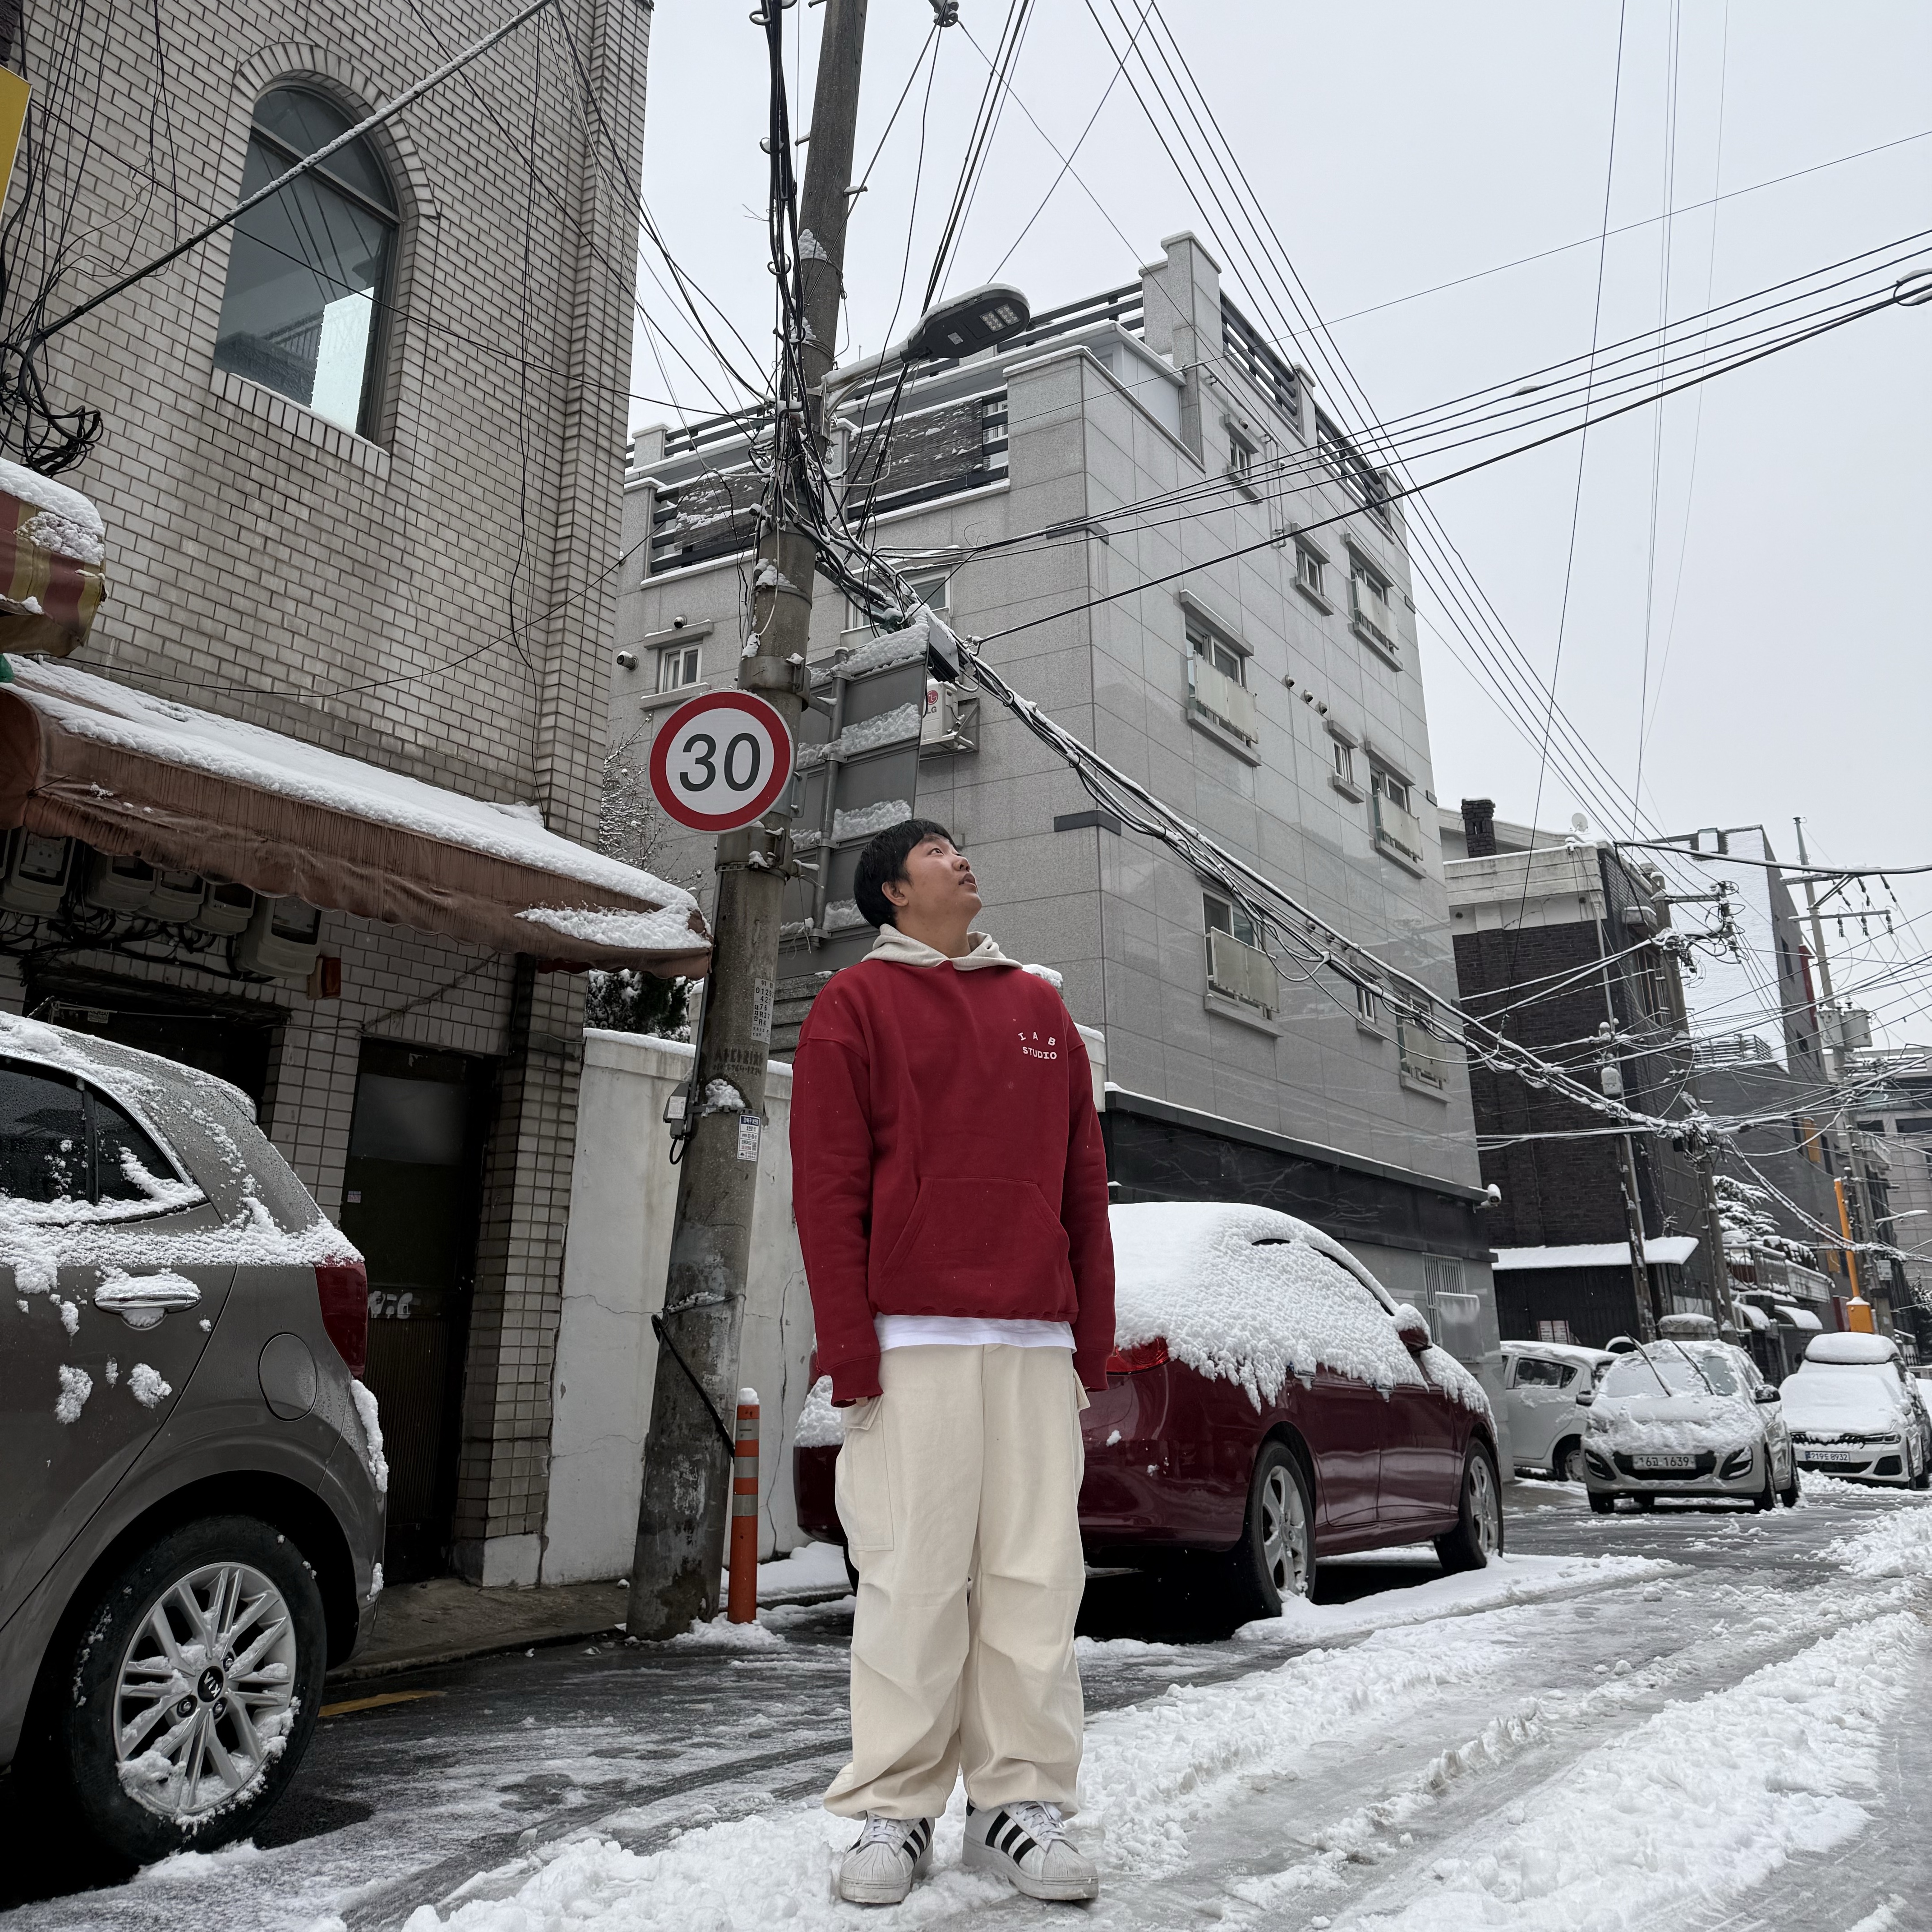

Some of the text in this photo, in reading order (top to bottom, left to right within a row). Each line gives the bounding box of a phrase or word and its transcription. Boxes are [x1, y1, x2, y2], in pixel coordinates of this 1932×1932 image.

[680, 733, 761, 791] 30
[1022, 1046, 1057, 1060] STUDIO
[1663, 1456, 1689, 1467] 1639
